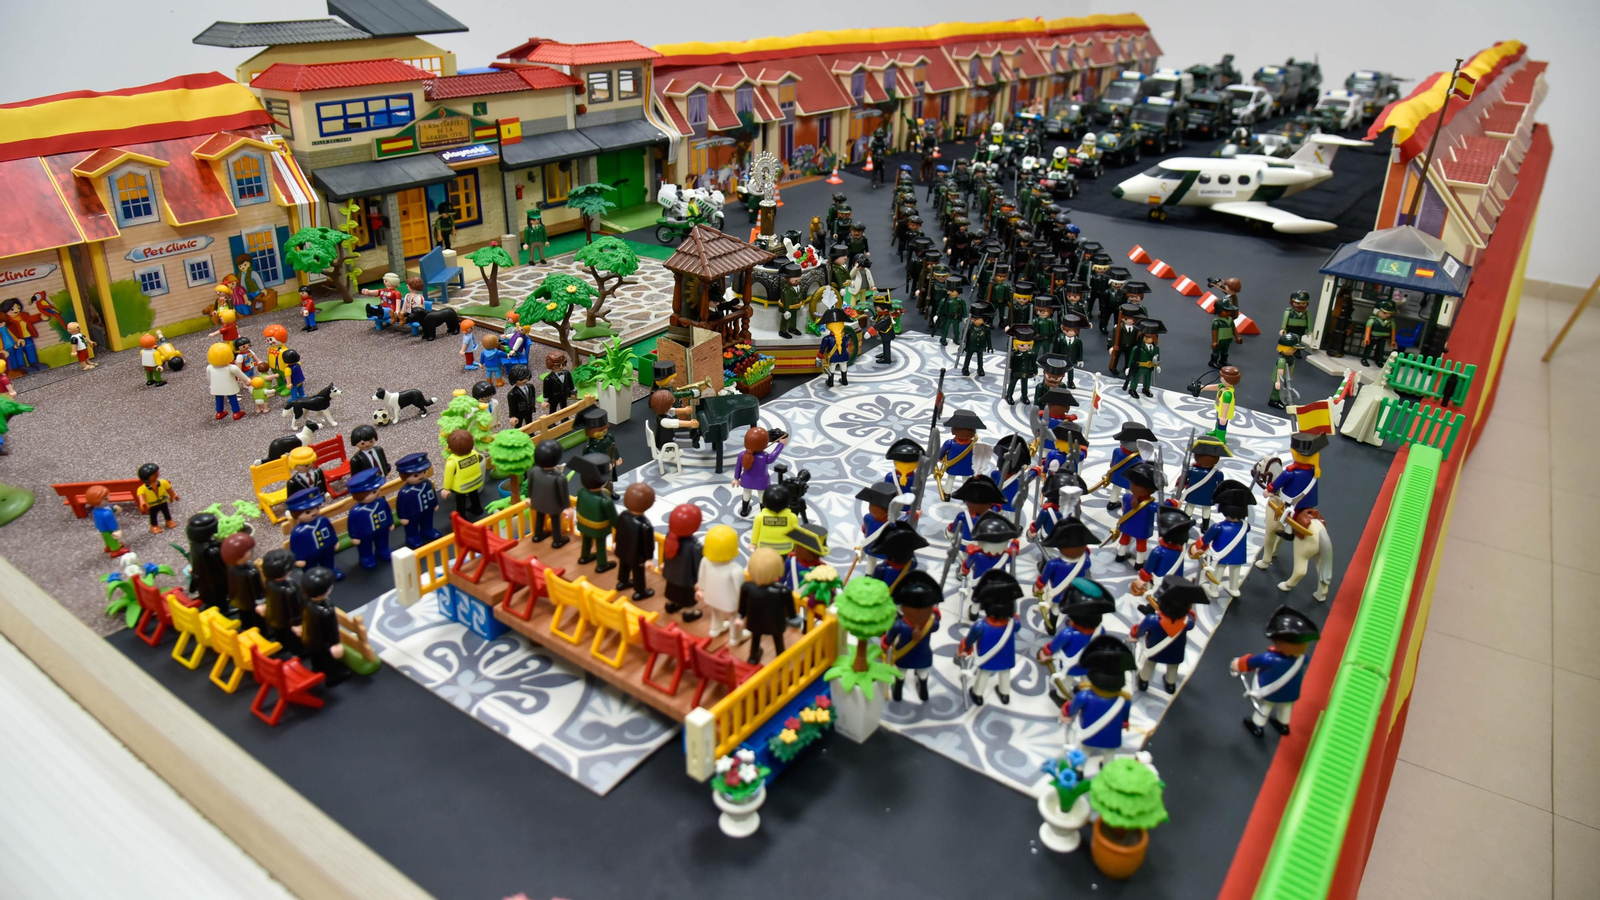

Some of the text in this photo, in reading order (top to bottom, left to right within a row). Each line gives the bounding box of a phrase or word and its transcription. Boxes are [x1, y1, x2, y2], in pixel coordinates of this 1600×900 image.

[423, 120, 464, 130] CASA CUARTEL
[442, 145, 489, 160] playmobil
[143, 239, 198, 258] Pet Clinic
